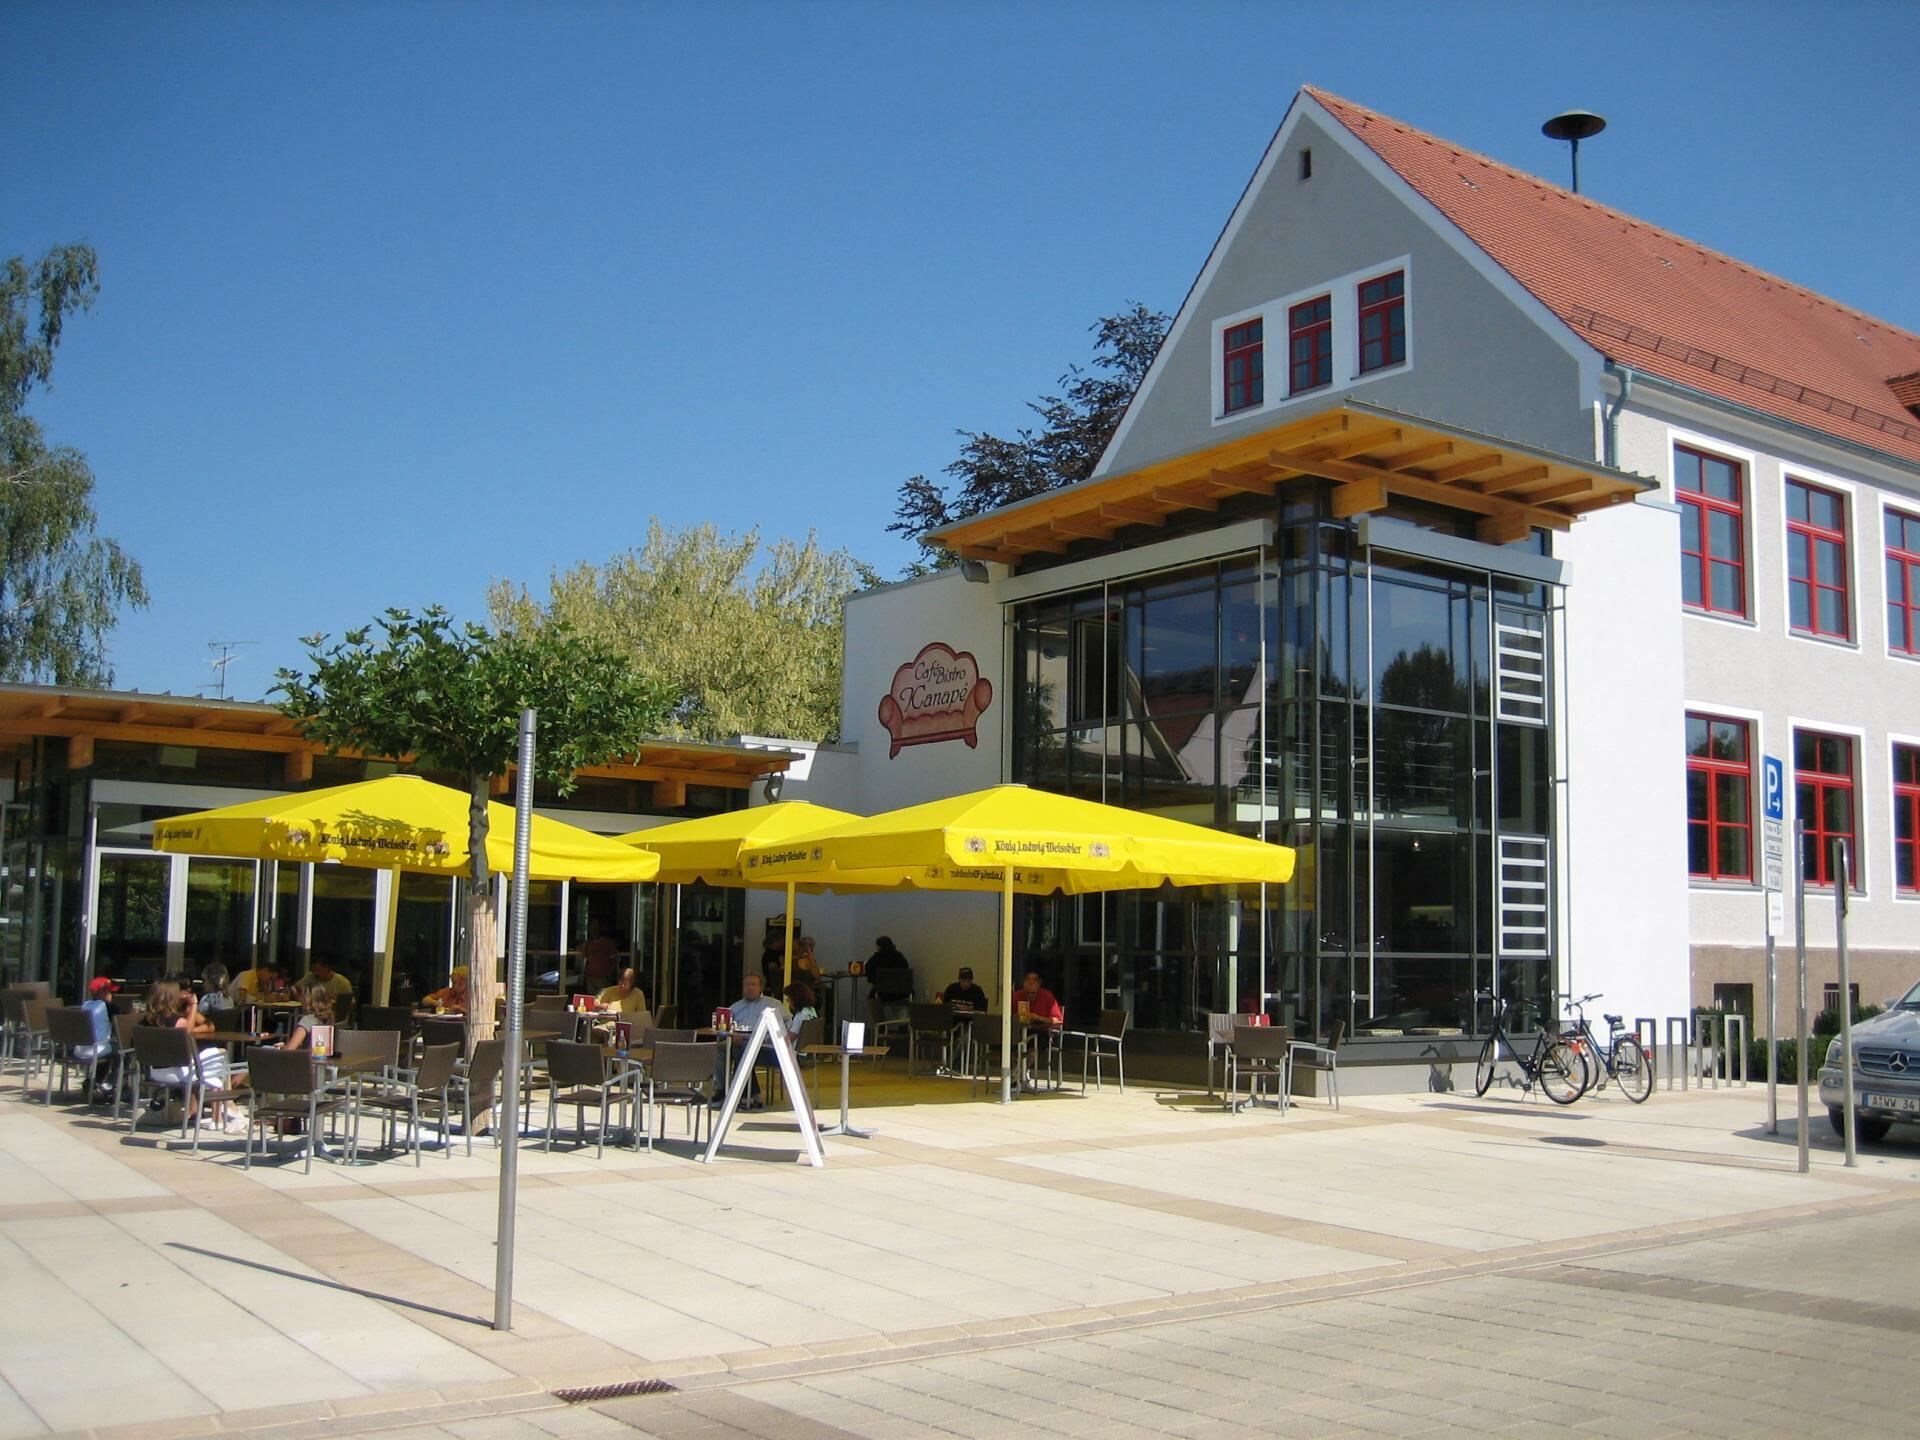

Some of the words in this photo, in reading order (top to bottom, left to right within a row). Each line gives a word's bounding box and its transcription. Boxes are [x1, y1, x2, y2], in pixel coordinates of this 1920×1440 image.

[936, 666, 966, 684] Bistro
[900, 682, 968, 712] Kanapé
[1766, 763, 1778, 810] P
[1017, 841, 1044, 855] Ludwig
